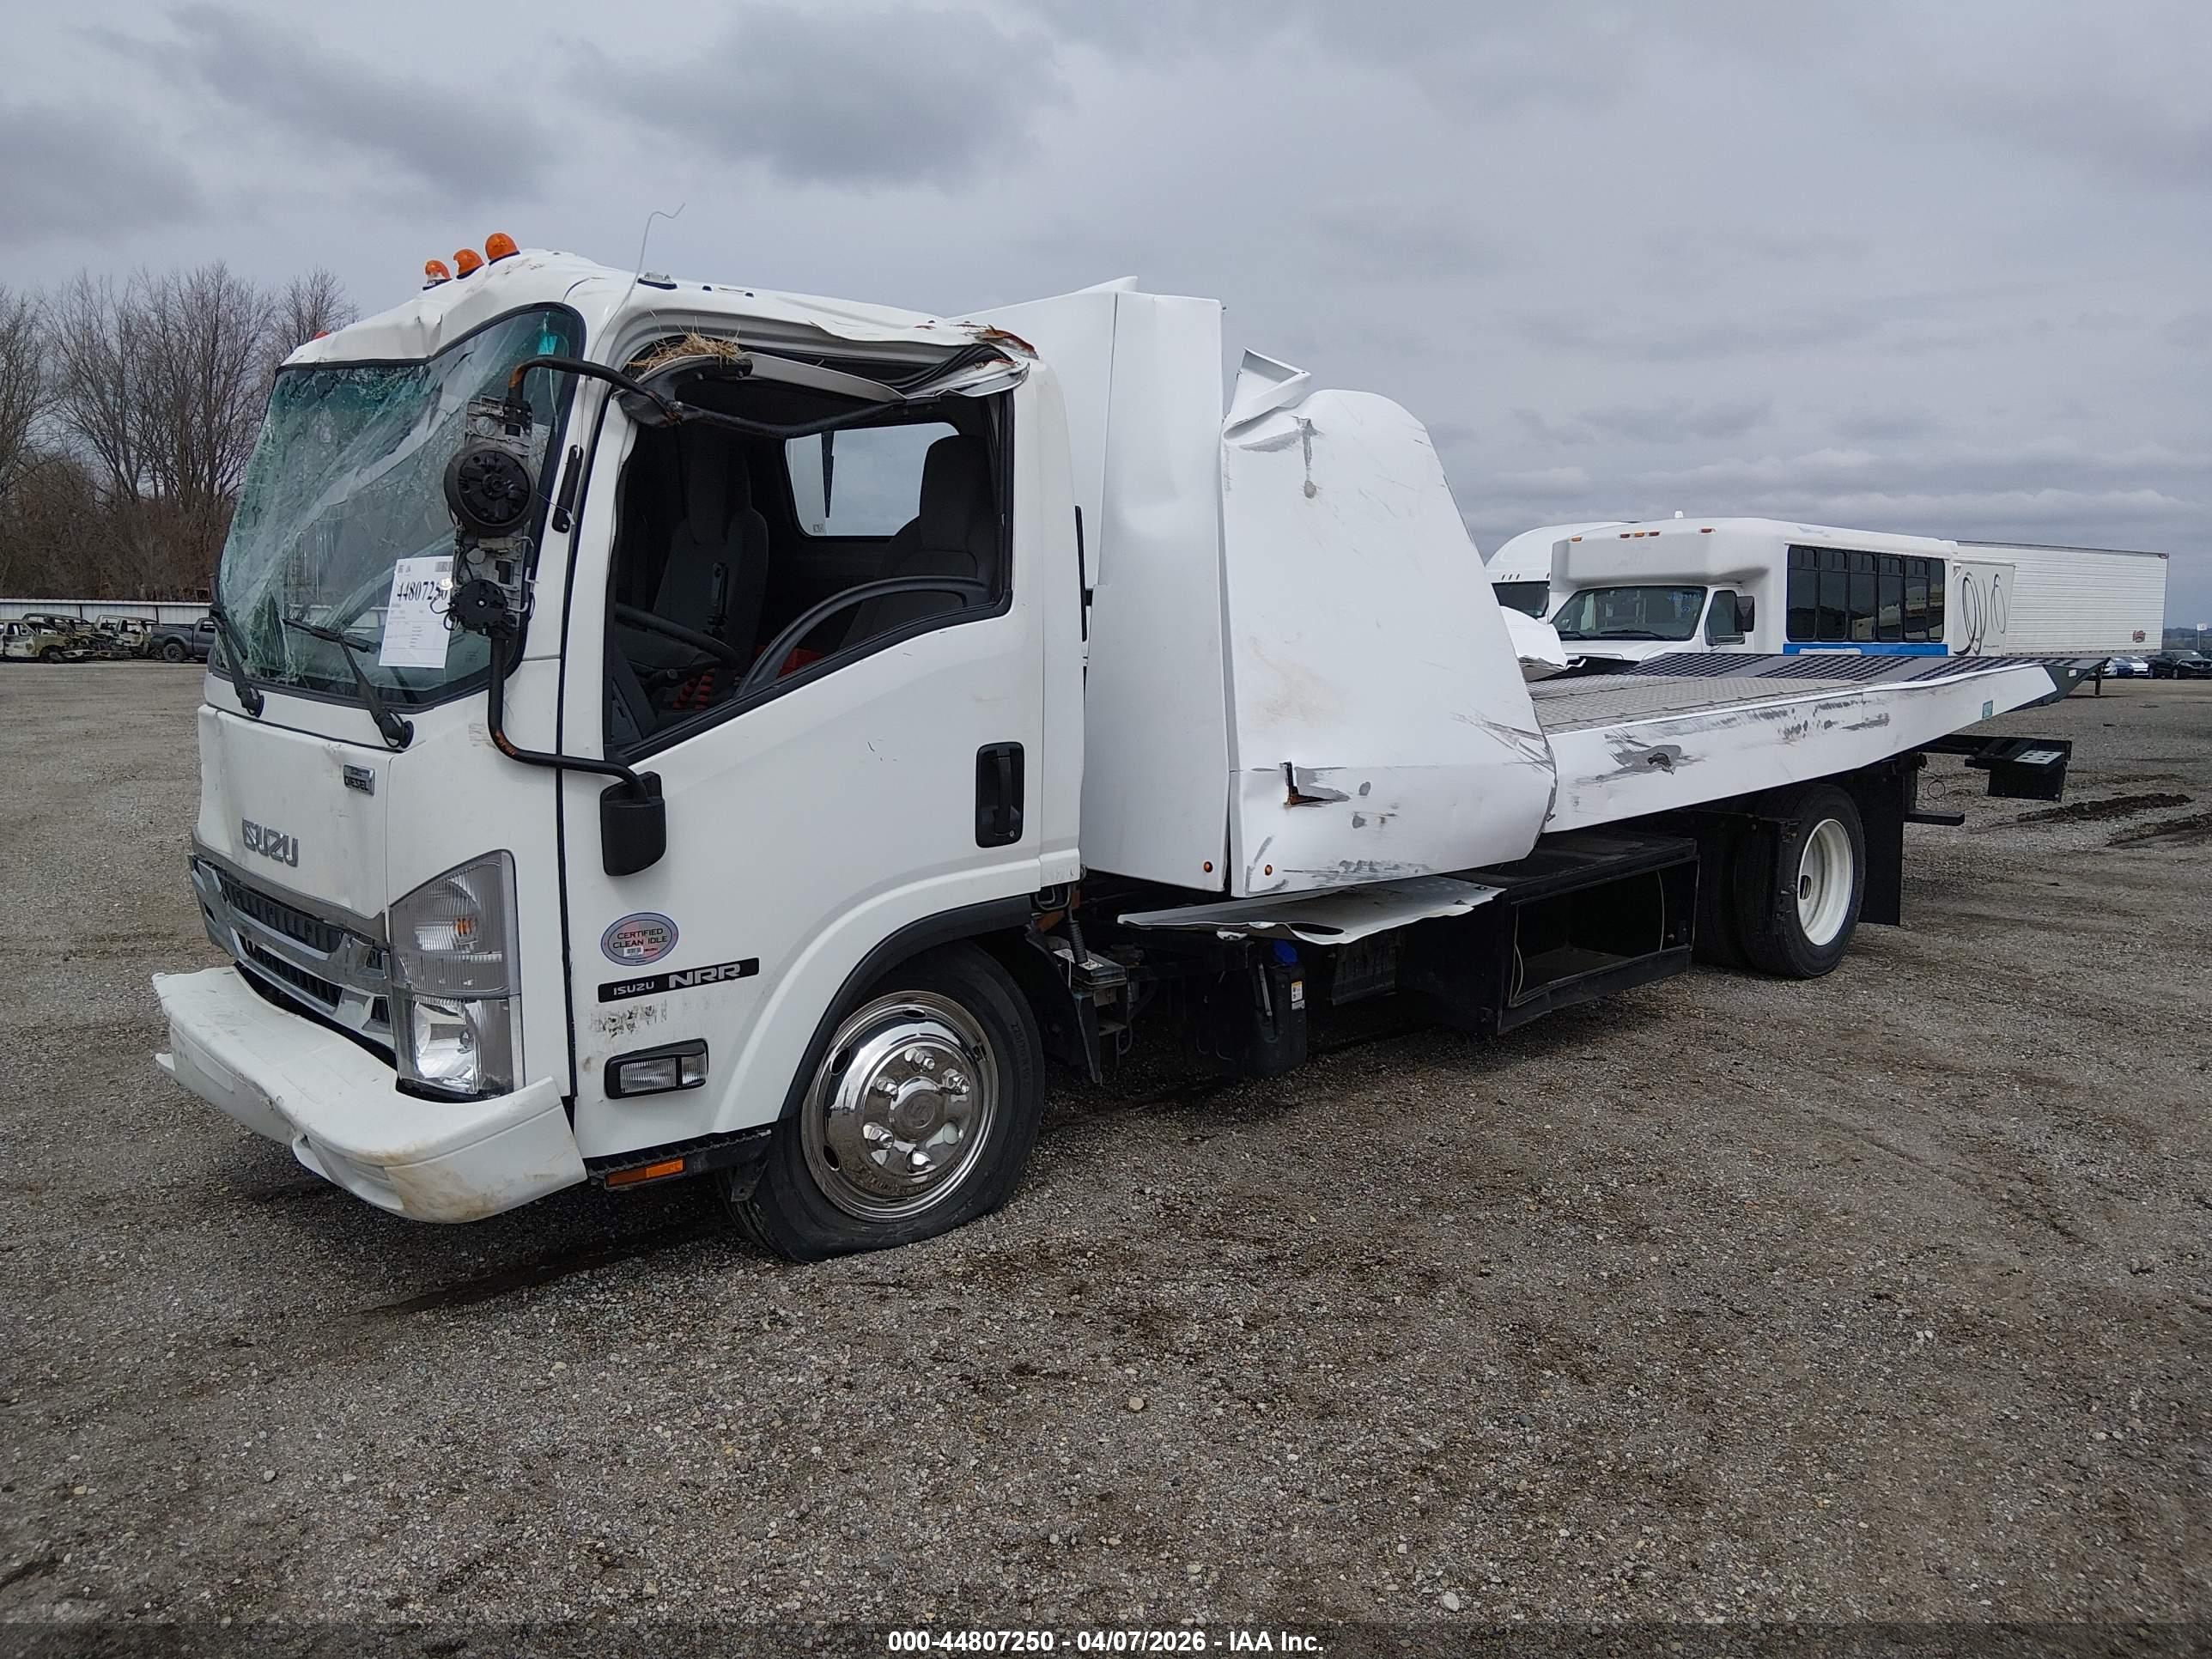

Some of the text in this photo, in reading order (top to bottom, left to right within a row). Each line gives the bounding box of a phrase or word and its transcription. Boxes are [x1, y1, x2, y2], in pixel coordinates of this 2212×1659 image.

[241, 817, 299, 867] ISUZU
[612, 935, 668, 949] CLEAN IDLE
[617, 927, 664, 939] CERTIFIED
[613, 963, 741, 996] ISUZU NRR
